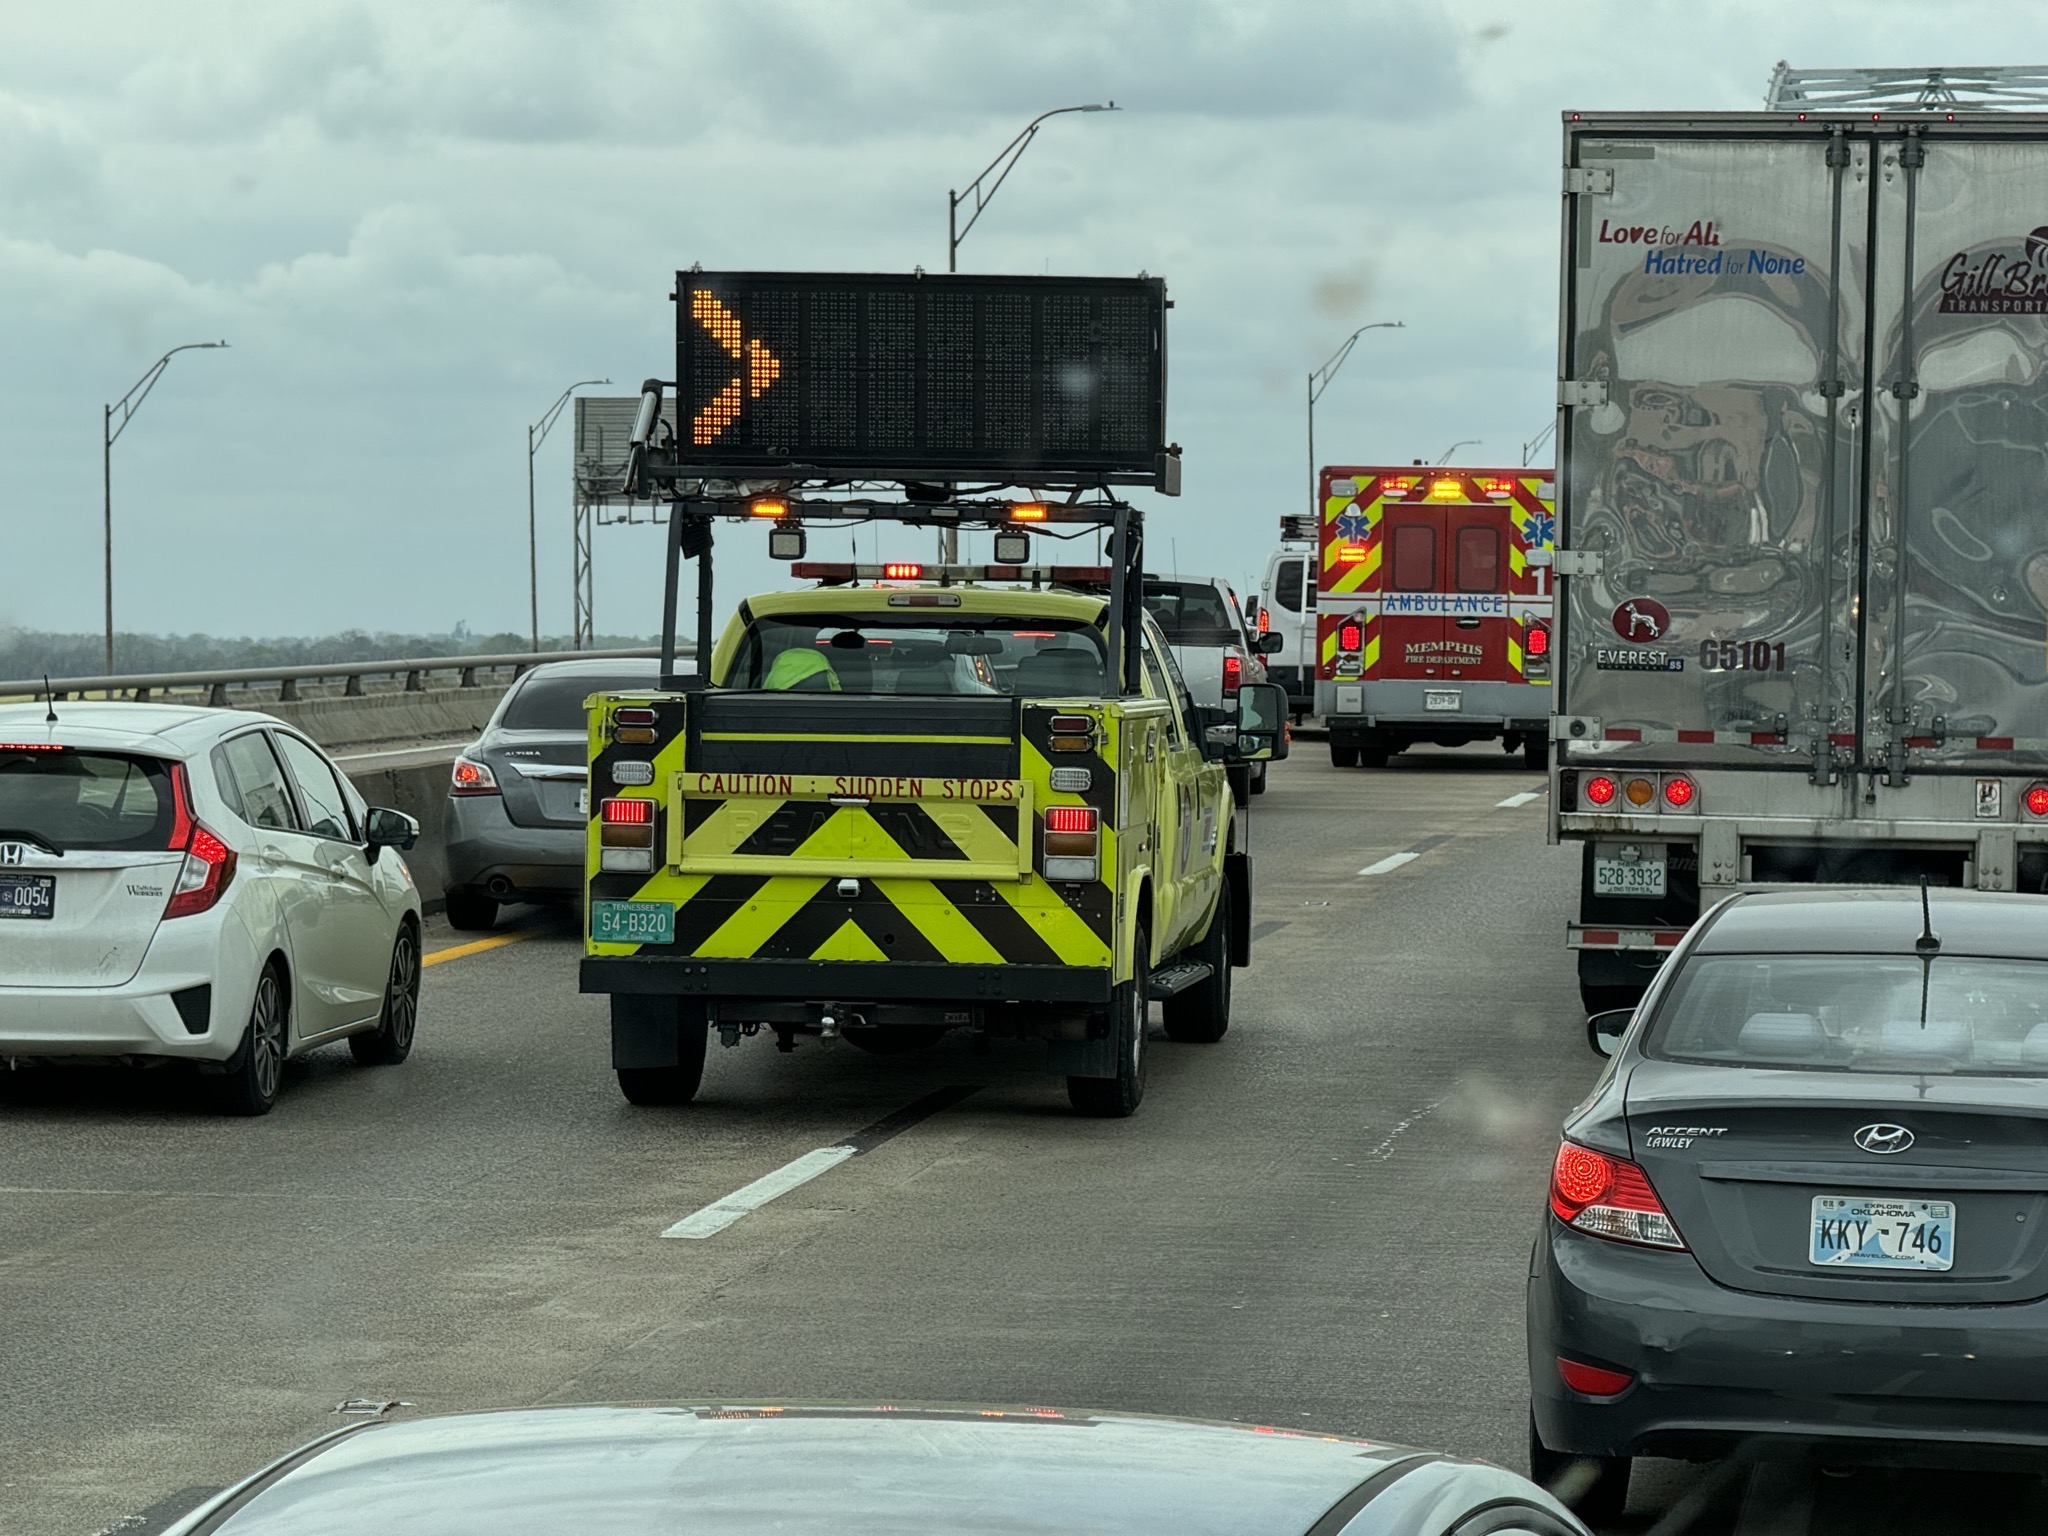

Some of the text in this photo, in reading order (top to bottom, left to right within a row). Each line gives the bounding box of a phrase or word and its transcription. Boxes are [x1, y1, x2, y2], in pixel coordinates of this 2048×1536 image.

[1599, 219, 1658, 244] Love
[1660, 225, 1684, 245] for
[1644, 250, 1805, 275] Hatred for None
[1941, 252, 2048, 295] Gill Br
[1531, 567, 1545, 596] 1
[1386, 595, 1503, 612] AMBULANCE
[1406, 641, 1483, 655] MEMPHIS
[1700, 639, 1785, 672] 65101
[1405, 655, 1482, 665] FIRE DEPARTMENT
[1597, 650, 1667, 665] EVEREST
[698, 774, 793, 796] CAUTION
[834, 776, 923, 798] SUDDEN
[942, 779, 1014, 801] STOPS
[14, 886, 50, 907] 0054
[612, 903, 656, 911] TENNESSEE
[1645, 1126, 1728, 1136] ACCENT
[1646, 1136, 1694, 1149] LAWLEY
[1851, 1208, 1916, 1218] OKLAHOMA
[1849, 1252, 1916, 1260] TRAVELOK.COM
